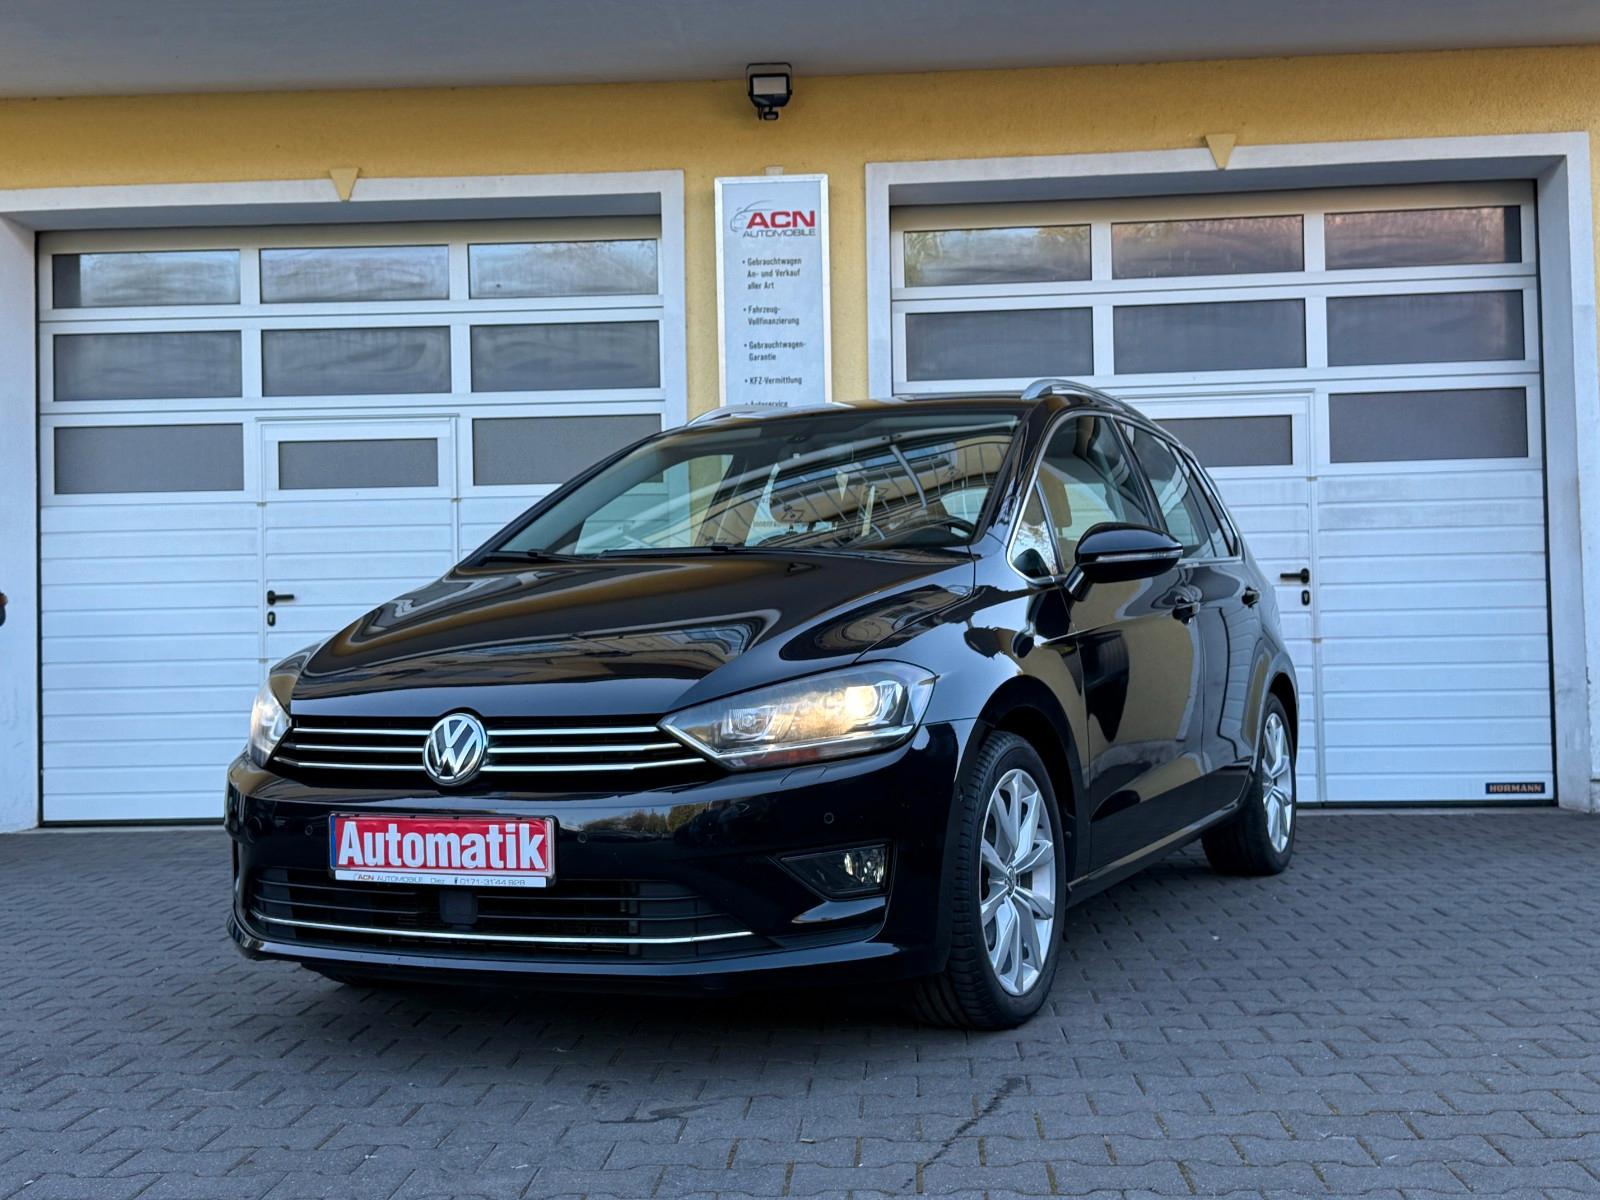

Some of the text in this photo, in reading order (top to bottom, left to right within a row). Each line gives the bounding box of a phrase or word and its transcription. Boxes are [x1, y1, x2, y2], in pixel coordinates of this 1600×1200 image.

[746, 210, 815, 229] ACN
[743, 229, 816, 238] AUTOMOBILE
[747, 258, 802, 266] Gebrauchtwagen
[747, 270, 759, 278] An-
[761, 269, 773, 277] und
[747, 281, 775, 290] aller Art
[748, 305, 781, 314] Fahrzeug-
[748, 317, 800, 326] Vollfinanzierung
[749, 341, 806, 350] Gebrauchtwagen-
[749, 353, 777, 361] Garantie
[749, 376, 803, 385] KFZ-Vermittlung
[338, 820, 546, 870] Automatik
[358, 873, 374, 881] ACN
[376, 874, 424, 883] AUTOMOBILE
